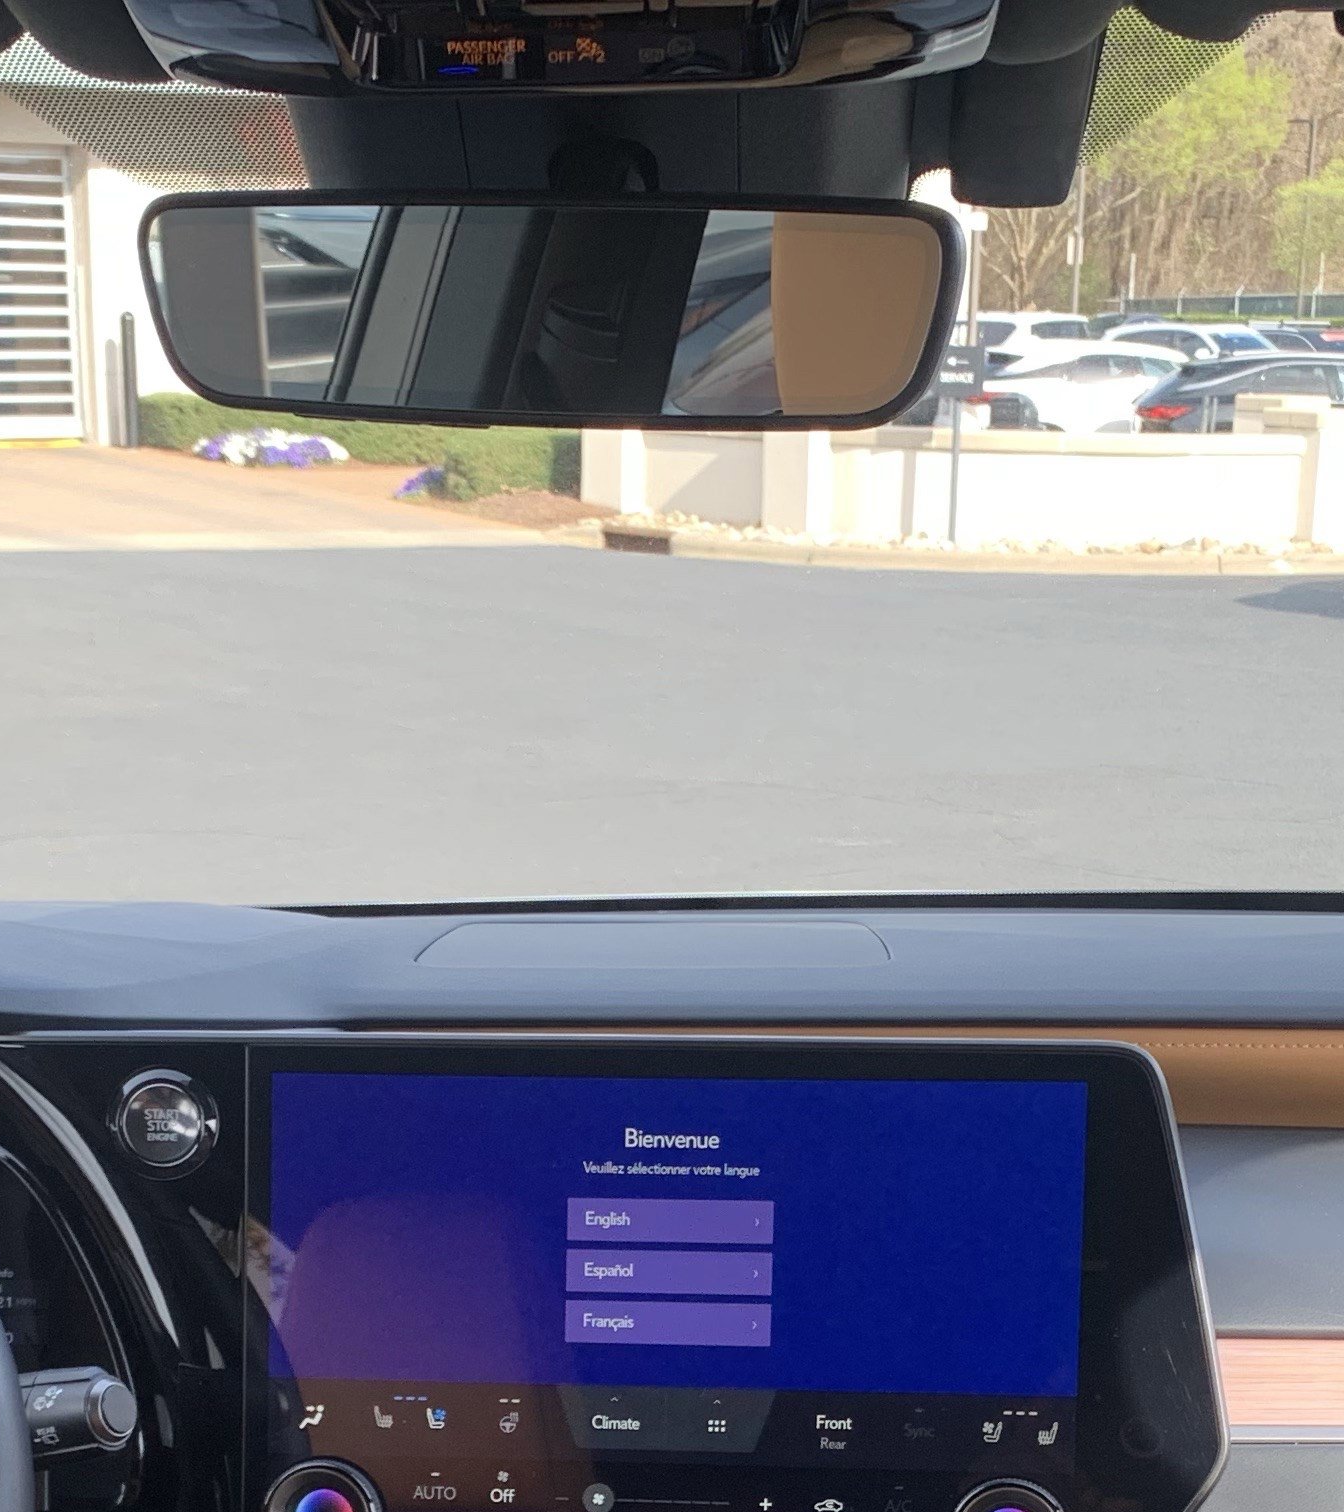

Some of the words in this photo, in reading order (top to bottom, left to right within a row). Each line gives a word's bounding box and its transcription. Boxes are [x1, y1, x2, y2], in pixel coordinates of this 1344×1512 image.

[447, 39, 526, 53] PASSENGER
[461, 51, 485, 65] AIR
[488, 51, 515, 65] BAG
[548, 51, 574, 64] OFF
[144, 1108, 180, 1120] START
[147, 1132, 178, 1142] ENGINE
[624, 1127, 721, 1149] Bienvenue
[582, 1160, 625, 1175] Veuillez
[627, 1161, 691, 1176] sélectionner
[693, 1164, 722, 1176] votre
[724, 1163, 761, 1179] langue
[585, 1211, 631, 1229] English
[583, 1262, 634, 1279] Español
[582, 1313, 634, 1332] Français
[591, 1414, 641, 1431] Climate
[815, 1414, 853, 1431] Front
[905, 1423, 935, 1440] Sync
[819, 1436, 847, 1450] Rear
[413, 1485, 457, 1500] AUTO
[489, 1488, 516, 1503] Off
